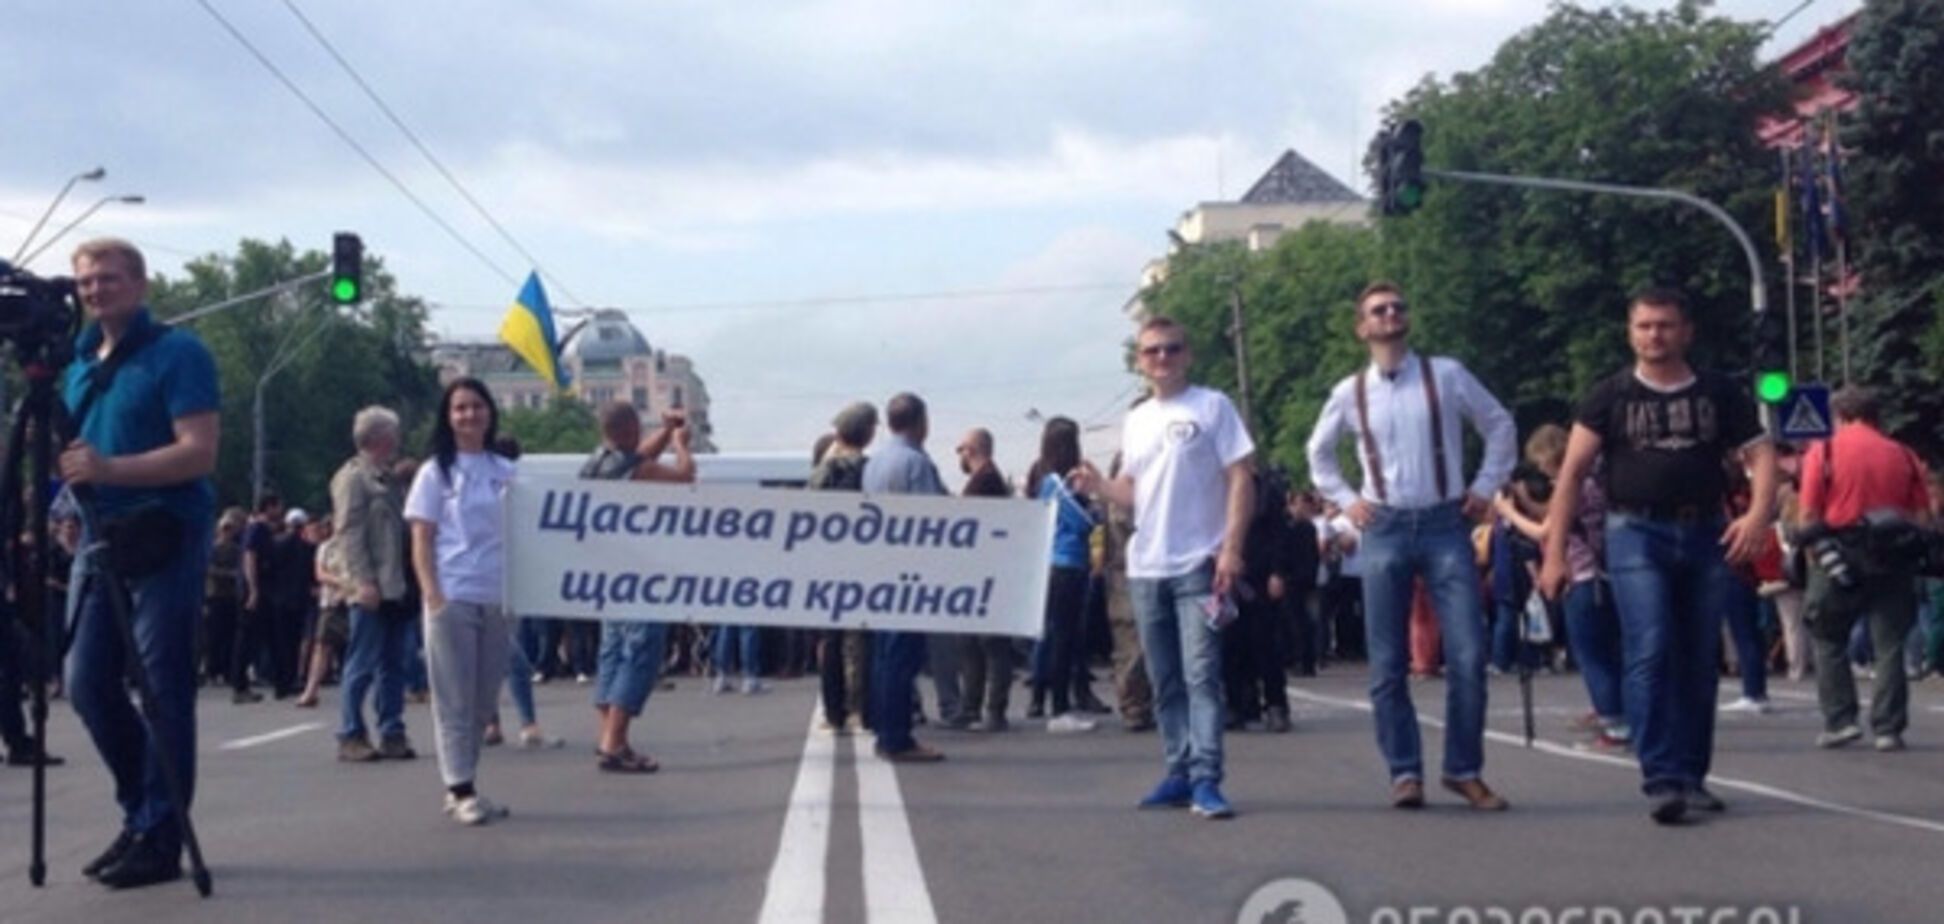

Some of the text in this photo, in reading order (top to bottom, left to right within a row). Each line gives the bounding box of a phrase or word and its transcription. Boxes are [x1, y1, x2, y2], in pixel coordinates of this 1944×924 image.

[538, 489, 775, 542] Щаслива
[784, 502, 979, 551] родина
[559, 569, 994, 622] щаслива країна!
